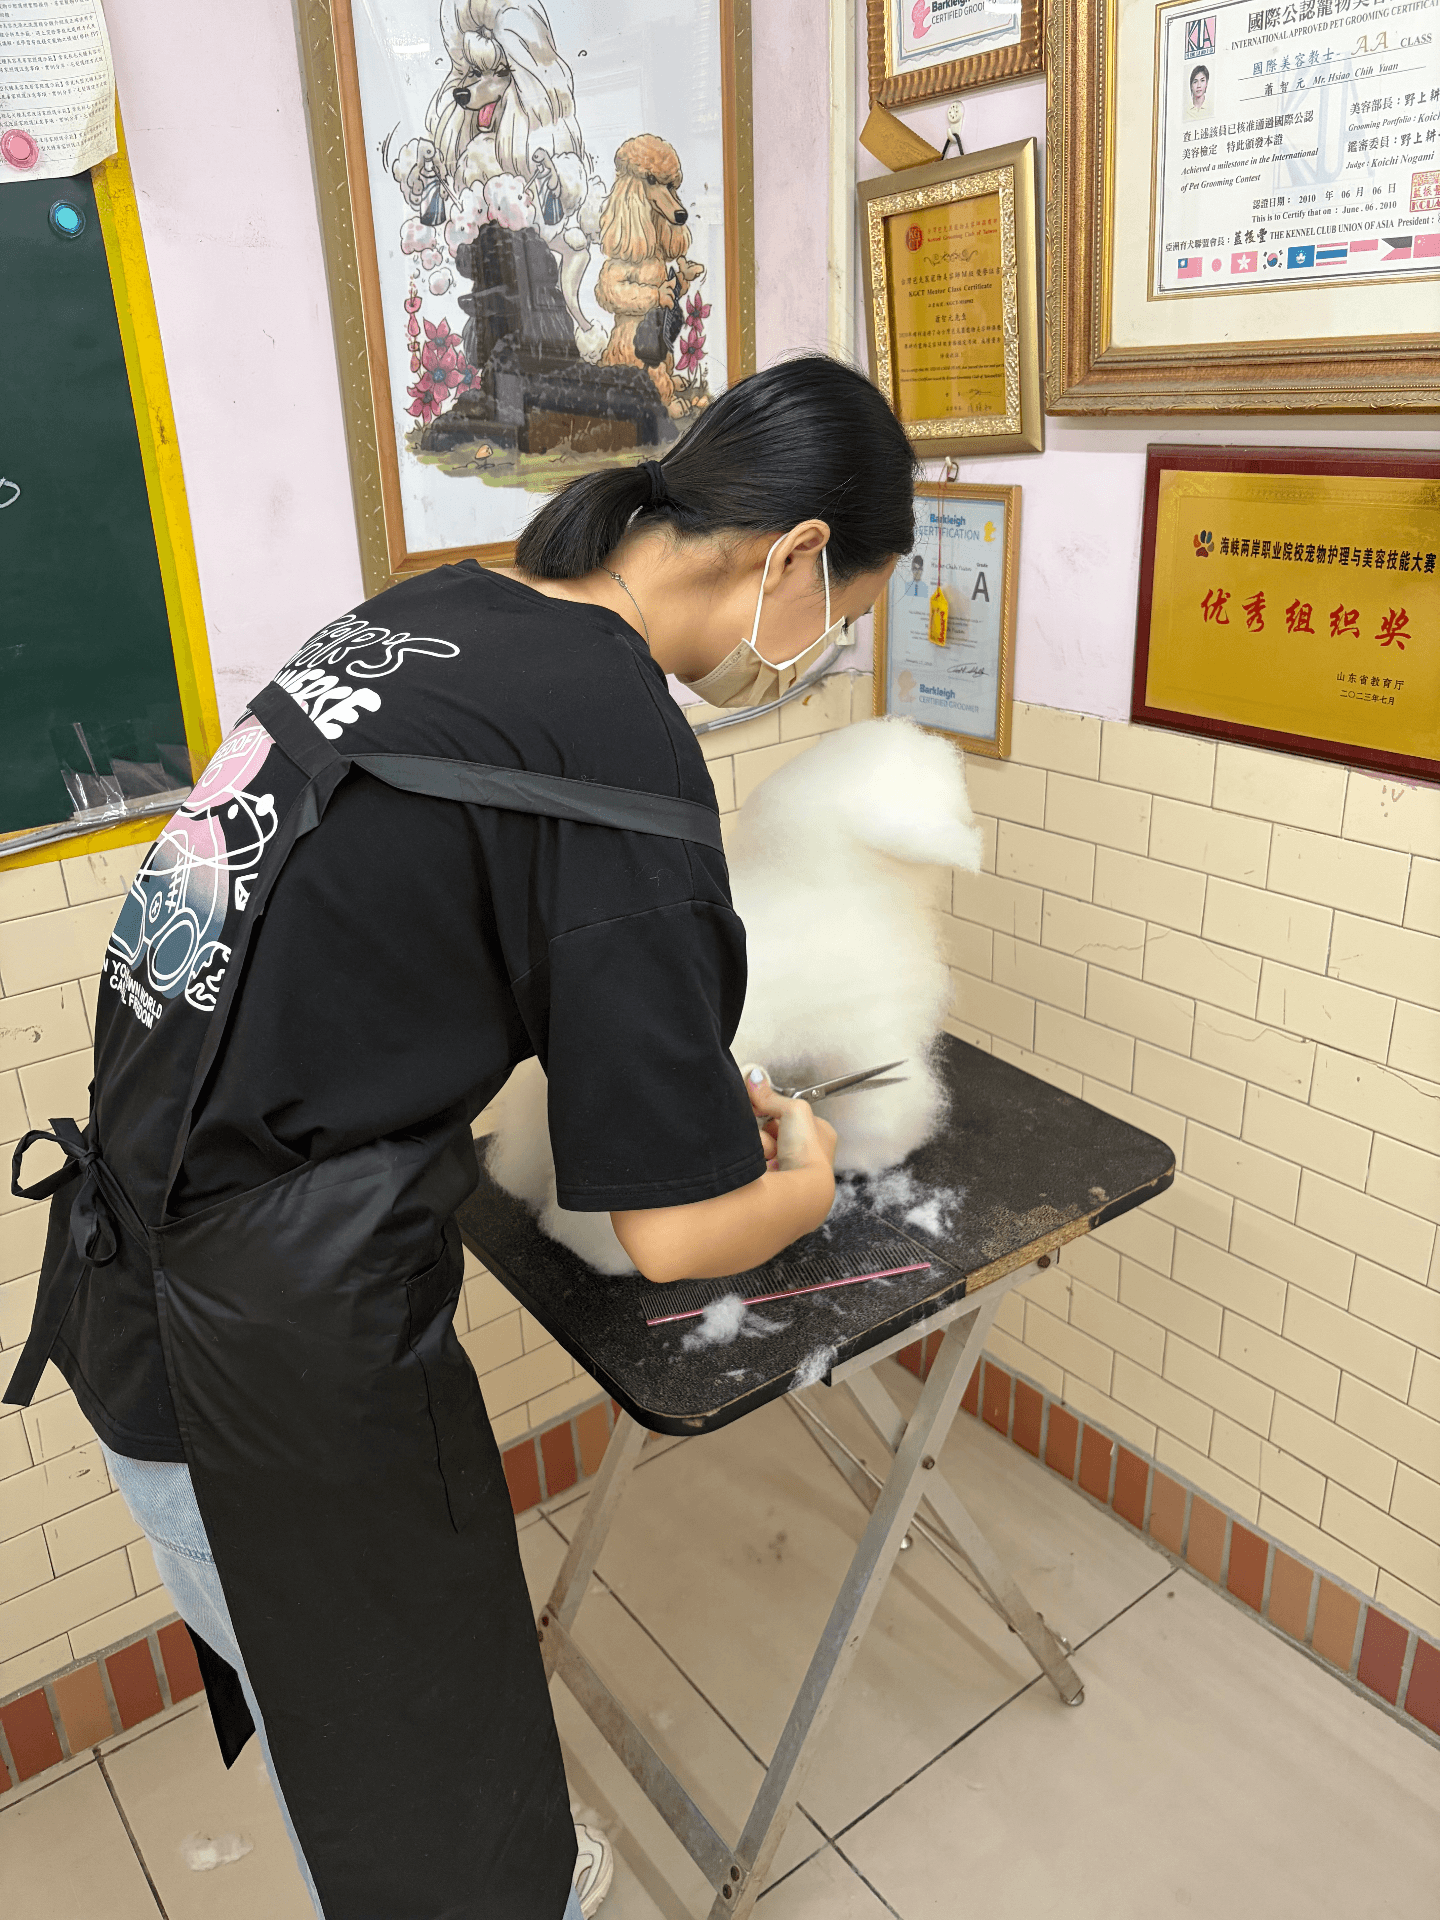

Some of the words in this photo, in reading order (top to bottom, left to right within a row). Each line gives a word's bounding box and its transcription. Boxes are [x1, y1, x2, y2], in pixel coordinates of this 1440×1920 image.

[932, 8, 963, 24] CERTIFIED
[964, 2, 985, 15] GROO
[1231, 27, 1288, 50] INTERNATIONAL
[1289, 20, 1328, 39] APPROVED
[1329, 17, 1345, 32] PET
[1345, 8, 1389, 26] GROOMING
[1400, 33, 1432, 48] CLASS
[1327, 71, 1351, 83] Hsiao
[1354, 65, 1374, 78] Chih
[1379, 63, 1399, 73] Yuan
[1348, 121, 1381, 132] Grooming
[1382, 115, 1412, 127] Portfolio
[1181, 164, 1211, 175] Achieved
[1217, 159, 1250, 170] milestone
[1250, 156, 1257, 165] in
[1259, 155, 1271, 164] the
[1271, 147, 1319, 163] International
[1346, 161, 1365, 170] Judge
[1371, 155, 1399, 168] Koichi
[1400, 150, 1435, 165] Nogami
[1180, 183, 1188, 193] of
[1188, 181, 1200, 191] Pet
[1200, 176, 1234, 189] Grooming
[1235, 174, 1261, 184] Contest
[1298, 194, 1316, 204] 2010
[1325, 190, 1334, 201] 年
[1341, 190, 1351, 199] 06
[1356, 186, 1364, 197] 月
[1372, 186, 1382, 196] 06
[1388, 182, 1397, 194] 日
[1252, 215, 1266, 223] This
[1274, 213, 1281, 221] to
[1282, 209, 1306, 219] Certify
[1307, 208, 1321, 217] that
[1342, 205, 1359, 214] June
[1365, 203, 1374, 211] 06
[1380, 200, 1397, 210] 2010
[1270, 230, 1285, 240] THE
[1285, 227, 1316, 239] KENNEL
[1316, 225, 1337, 236] CLUB
[1338, 222, 1363, 233] UNION
[1364, 220, 1376, 231] OF
[1375, 219, 1395, 230] ASIA
[1397, 215, 1430, 227] President
[963, 283, 993, 291] Certificate
[1219, 536, 1438, 574] 海峡两岸职业院校宠物护理与美容技能大赛
[971, 571, 990, 602] A
[1200, 587, 1412, 651] 优秀组织奖
[919, 684, 956, 700] Barkleigh
[1336, 671, 1405, 691] 山东省教育厅
